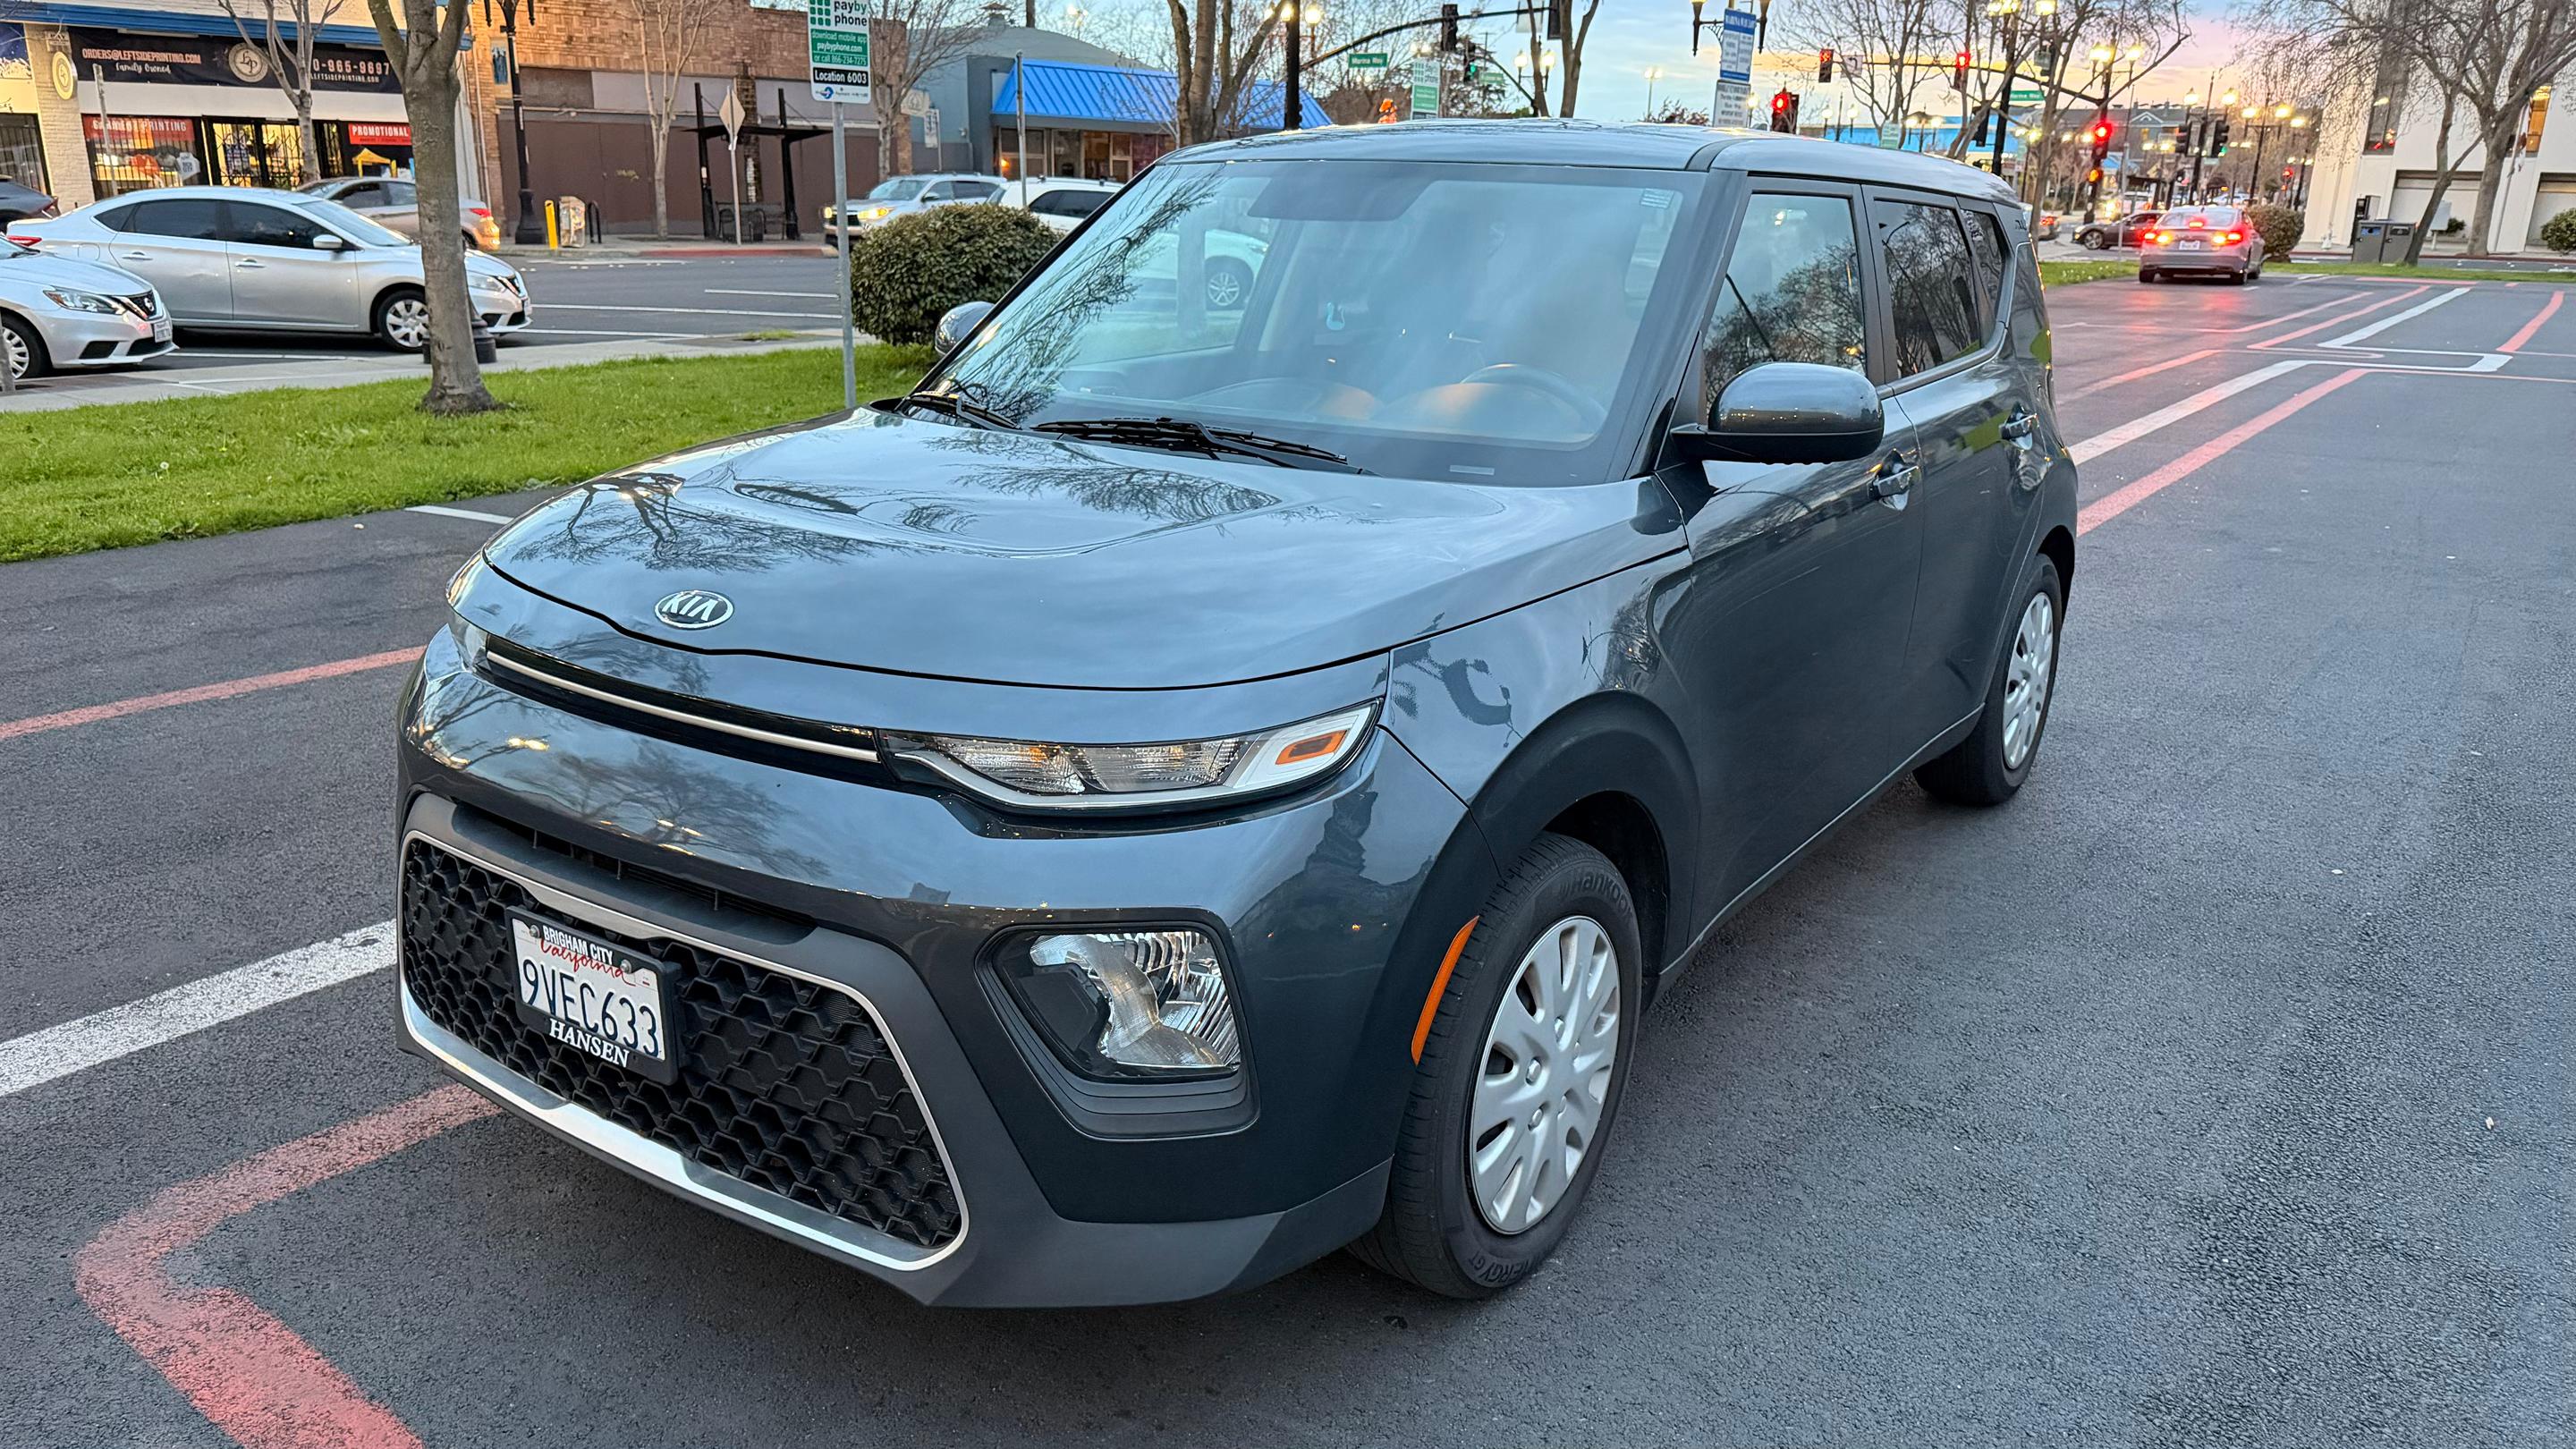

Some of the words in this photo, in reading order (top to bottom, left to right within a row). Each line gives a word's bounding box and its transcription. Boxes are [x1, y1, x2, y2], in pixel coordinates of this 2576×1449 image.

[835, 13, 868, 27] phone
[811, 31, 837, 40] download
[838, 34, 856, 43] mobile
[817, 41, 863, 52] paybyphone.com
[81, 48, 201, 64] ORDERS@LEFTSIDEPRINTING.COM
[821, 54, 831, 63] call
[115, 62, 142, 73] Family
[144, 63, 172, 74] Owned
[814, 70, 845, 82] Location
[846, 72, 868, 84] 6003
[141, 121, 187, 131] PRINTING
[352, 125, 409, 137] PROMOTIONAL
[661, 592, 719, 622] KIA
[542, 925, 589, 956] BRIGHAM
[589, 944, 614, 965] CITY
[540, 937, 636, 987] California
[522, 958, 659, 1058] 9VEC633
[549, 1018, 630, 1068] HANSEN
